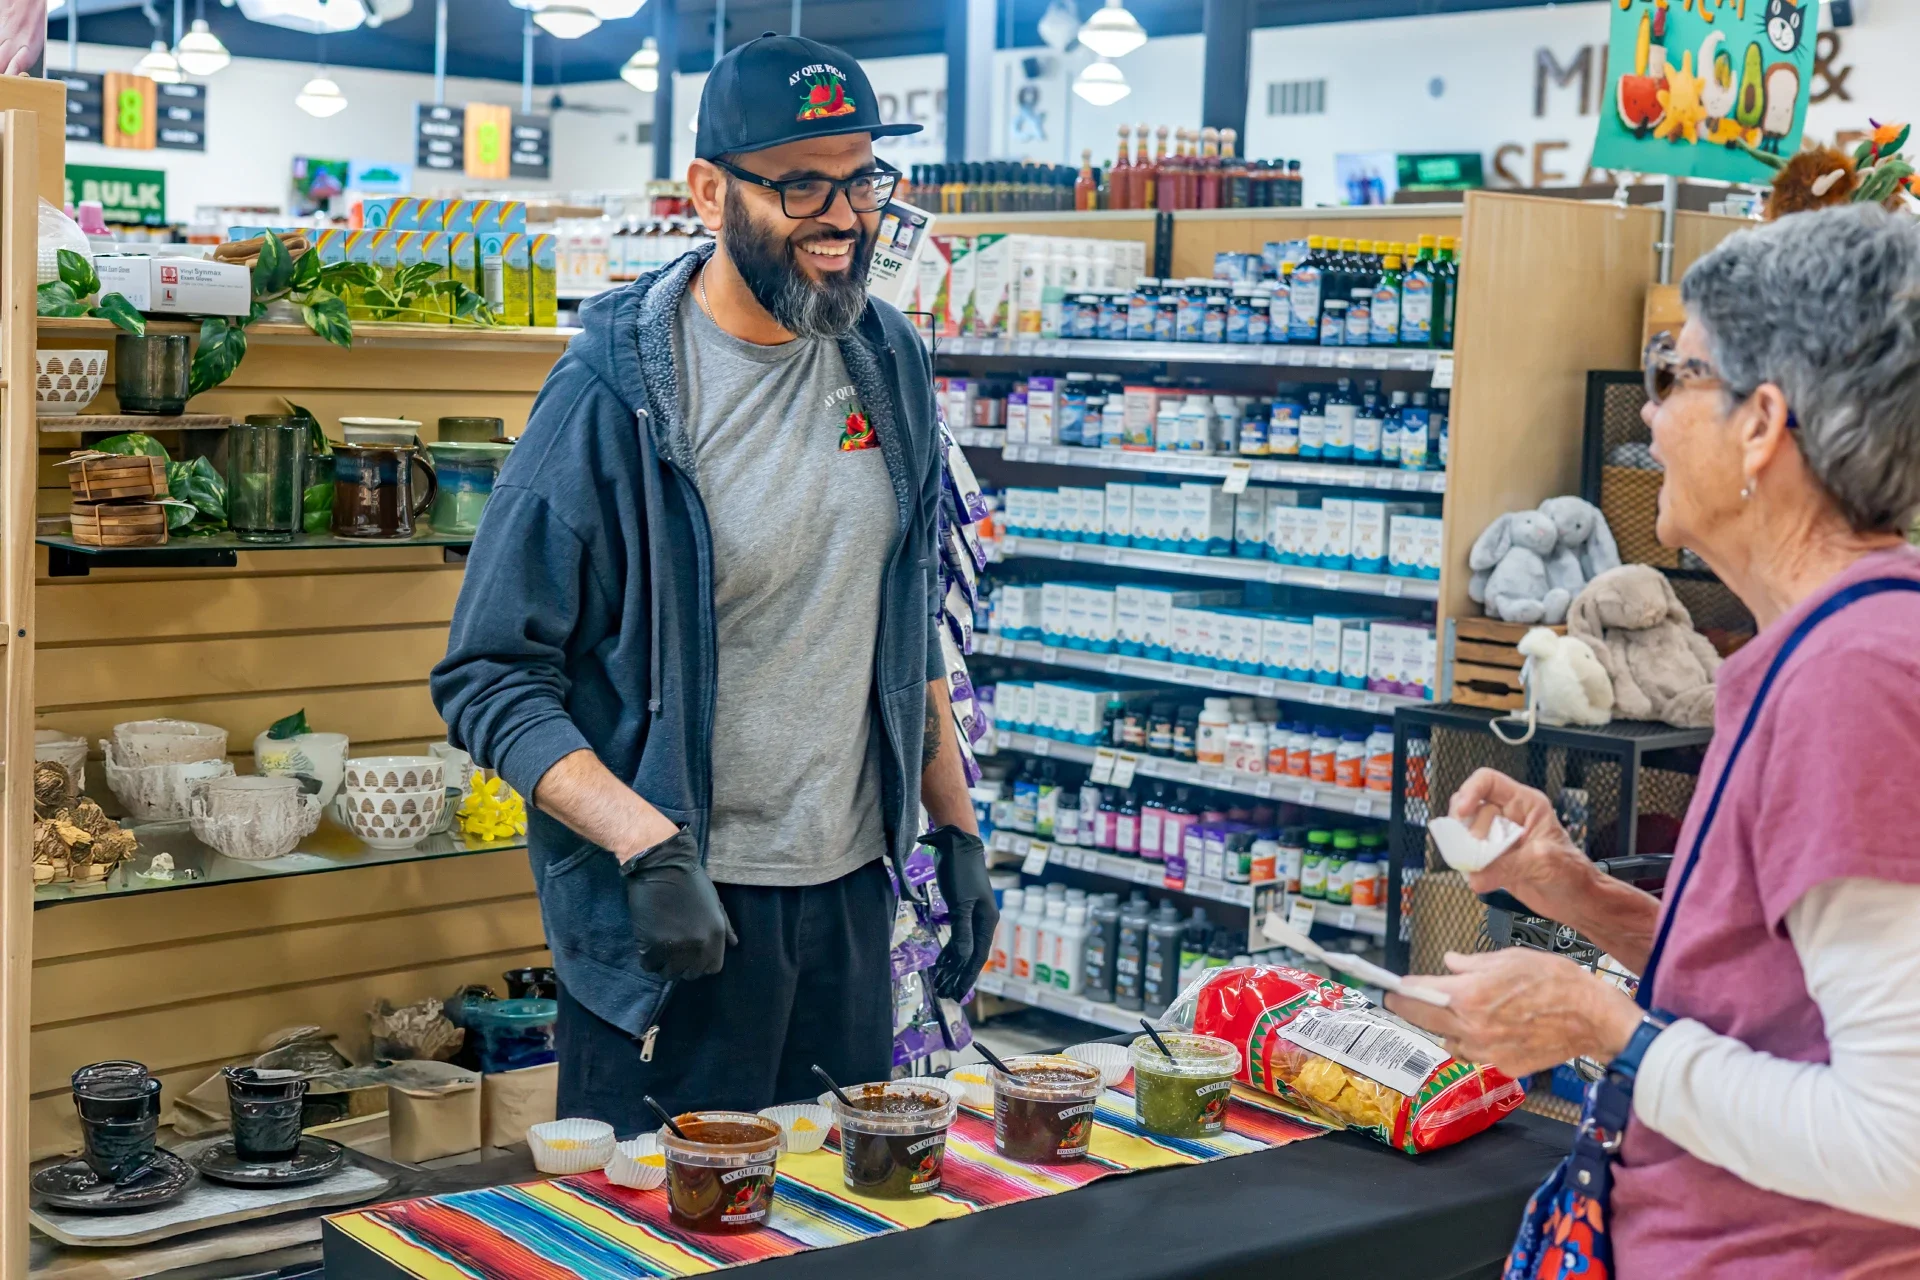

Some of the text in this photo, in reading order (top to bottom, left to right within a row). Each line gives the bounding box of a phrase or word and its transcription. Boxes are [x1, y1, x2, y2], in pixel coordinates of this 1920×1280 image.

[789, 63, 847, 86] AY QUE PICA!
[118, 88, 142, 135] 8
[83, 180, 161, 208] BULK
[883, 257, 903, 272] OFF
[194, 267, 222, 277] Synmax
[166, 289, 173, 299] L
[836, 385, 858, 401] QUE
[966, 494, 975, 502] 24
[962, 717, 971, 725] 24
[1198, 1086, 1207, 1096] AY
[1060, 1111, 1070, 1119] AY
[910, 1145, 919, 1153] AY
[724, 1172, 735, 1182] AY
[737, 1167, 756, 1178] QUE
